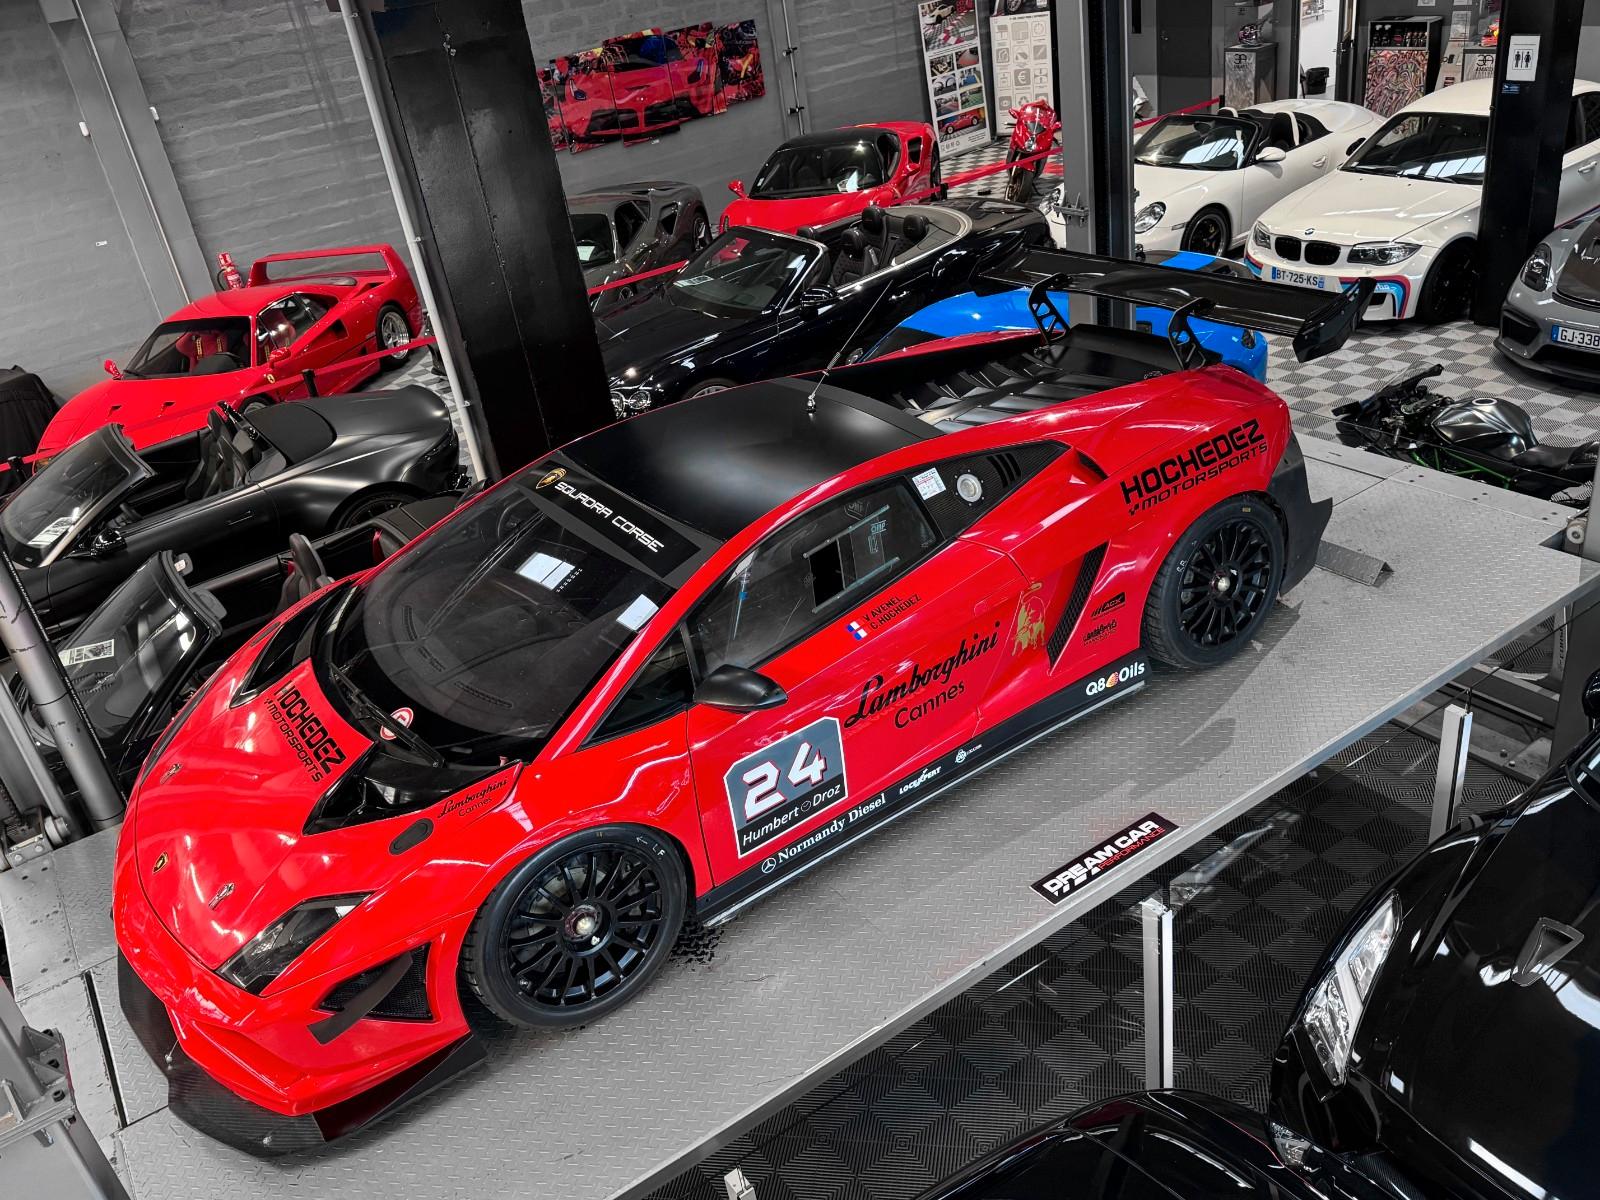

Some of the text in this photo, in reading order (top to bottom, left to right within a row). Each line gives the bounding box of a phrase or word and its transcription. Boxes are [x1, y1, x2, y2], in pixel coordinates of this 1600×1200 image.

[1276, 269, 1318, 286] BT-725-KS
[1120, 419, 1264, 504] HOCHEDEZ
[1141, 442, 1267, 511] MOTORSPORTS
[554, 481, 664, 553] SQUADRA CORSE
[872, 596, 903, 617] AVENEL
[844, 621, 1000, 728] Lamborghini
[895, 680, 965, 728] Cannes
[1085, 661, 1145, 696] Q8 Oils
[266, 700, 324, 783] MOTORSPORTS
[437, 776, 508, 819] Lamborghini
[458, 797, 493, 817] Cannes
[743, 741, 827, 822] 24
[742, 784, 841, 847] Humbert Droz
[777, 794, 886, 864] Normandy Diesel
[1098, 826, 1166, 871] PERFORMANCE
[1042, 820, 1160, 897] DREAM CAR
